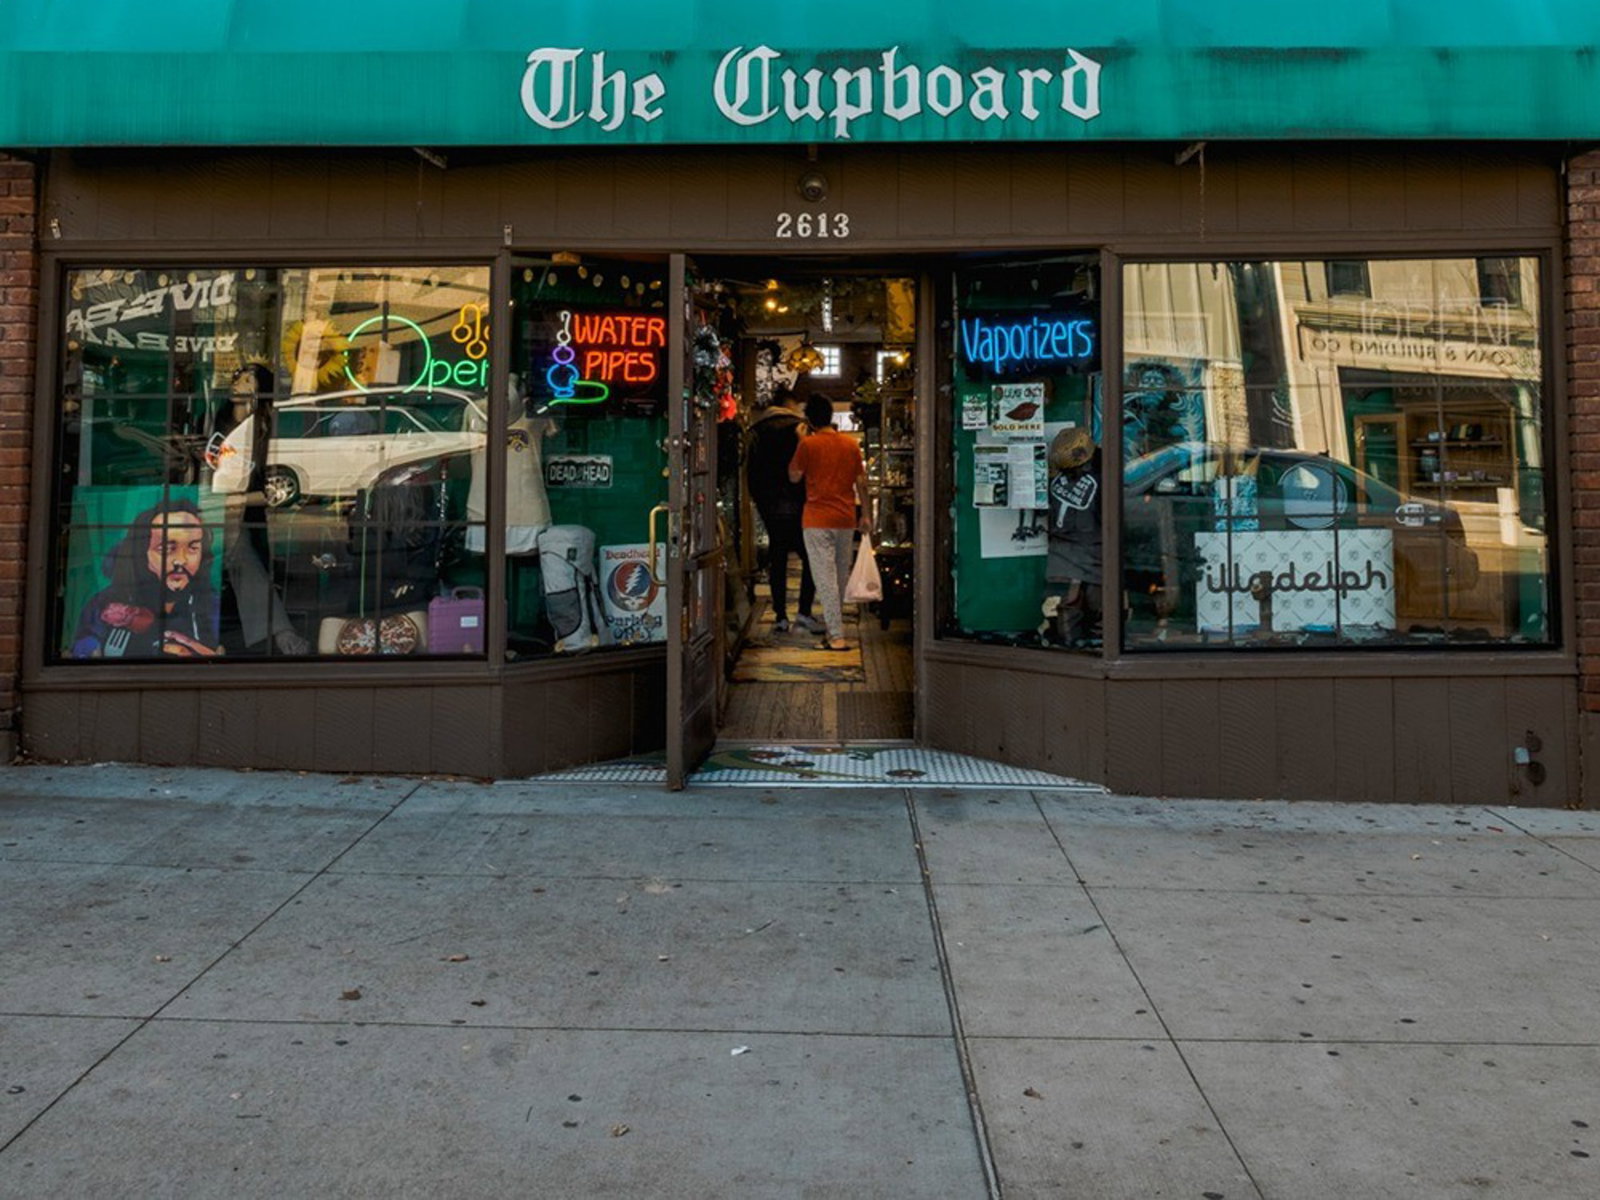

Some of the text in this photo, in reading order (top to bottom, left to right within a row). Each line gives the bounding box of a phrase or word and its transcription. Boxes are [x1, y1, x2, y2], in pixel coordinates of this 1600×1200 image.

[520, 44, 1102, 140] The Cupboard
[776, 212, 850, 238] 2613
[574, 314, 665, 347] WATER
[961, 316, 1093, 374] Vaporizers
[584, 351, 656, 382] PIPES
[549, 464, 610, 481] DEAD HEAD
